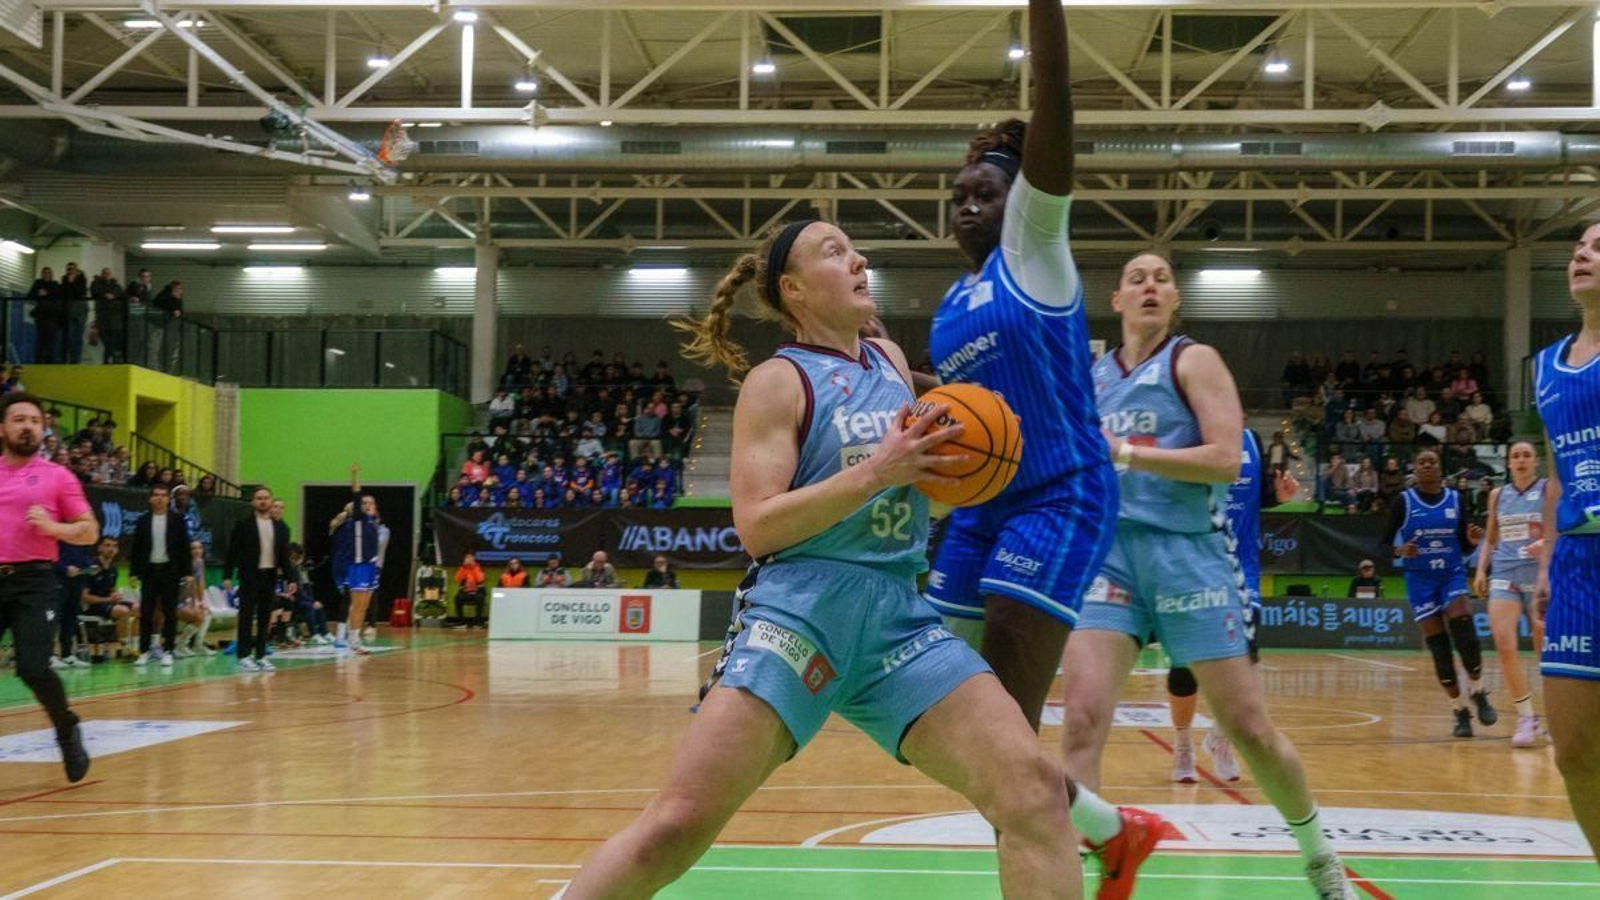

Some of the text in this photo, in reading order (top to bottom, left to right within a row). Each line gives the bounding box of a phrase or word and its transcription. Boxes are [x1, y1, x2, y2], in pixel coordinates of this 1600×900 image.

[870, 498, 912, 541] 52
[544, 602, 610, 613] CONCELLO
[551, 614, 602, 625] DE VIGO
[1260, 599, 1320, 626] máis
[1343, 607, 1404, 633] auga
[757, 622, 808, 656] CONCELLO
[760, 631, 800, 662] DE VIGO
